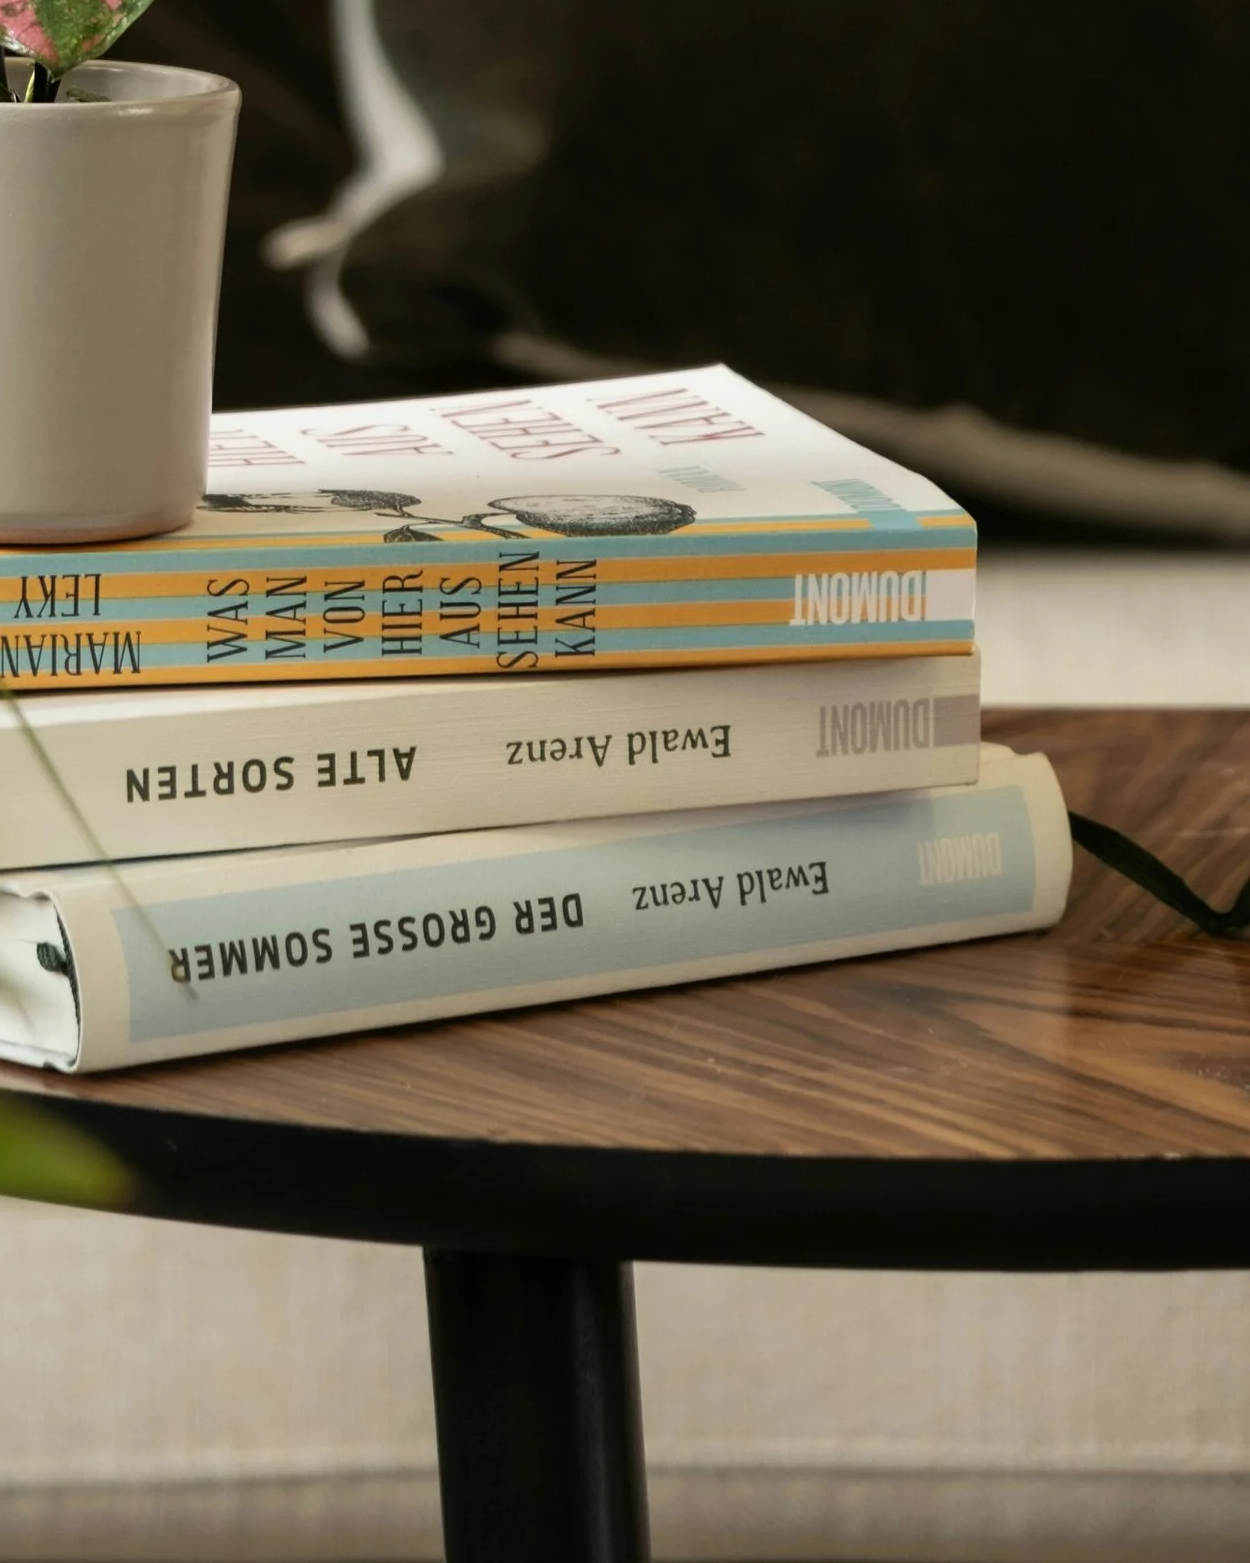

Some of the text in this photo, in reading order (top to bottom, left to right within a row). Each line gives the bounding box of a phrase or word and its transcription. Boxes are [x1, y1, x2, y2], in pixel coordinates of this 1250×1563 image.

[299, 423, 454, 456] AUS
[429, 399, 622, 460] SEHEN
[586, 388, 766, 446] KANN
[13, 573, 102, 619] LEKY
[206, 578, 250, 663] WAS
[264, 575, 308, 660] MAN
[322, 579, 366, 653] VON
[381, 569, 424, 656] HIER
[439, 576, 483, 649] AUS
[496, 550, 540, 669] SEHEN
[554, 558, 598, 658] KANN
[789, 569, 927, 627] DUMONT
[506, 724, 732, 767] Ewald Arenz
[815, 697, 934, 759] DUMONT
[125, 745, 418, 804] ALTE SORTEN
[631, 860, 831, 911] Ewald Arenz
[916, 831, 1002, 886] DUMONT
[168, 892, 585, 984] DER GROSSE SOMMER
